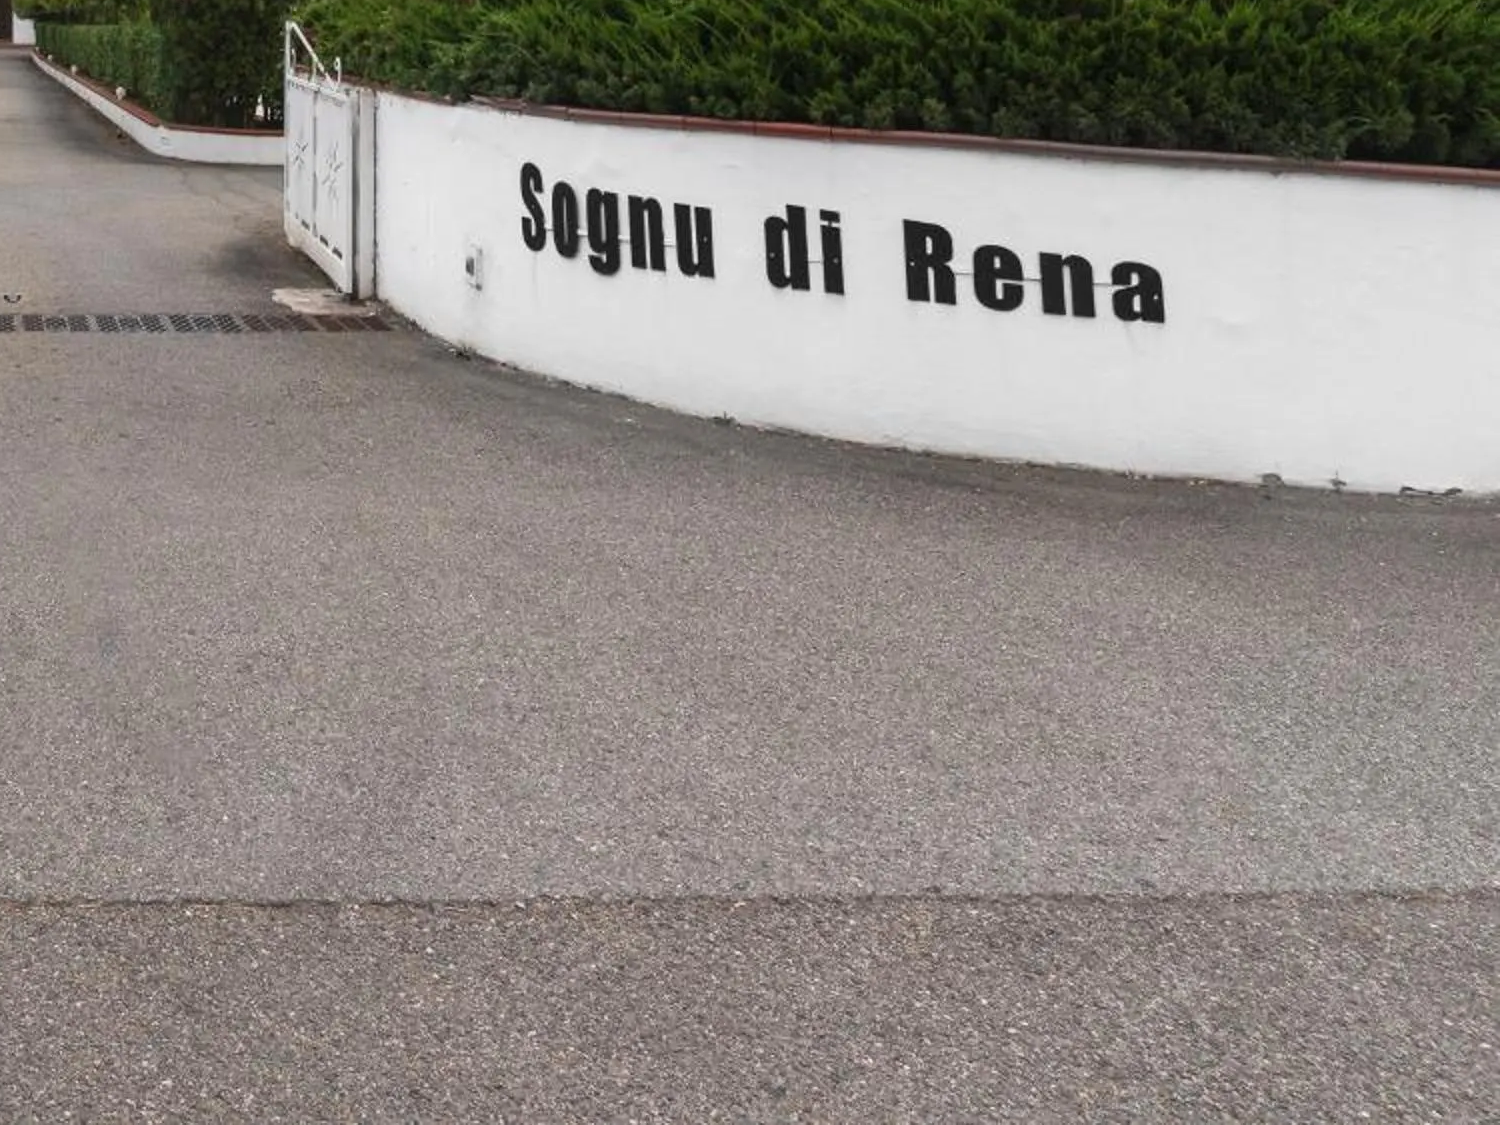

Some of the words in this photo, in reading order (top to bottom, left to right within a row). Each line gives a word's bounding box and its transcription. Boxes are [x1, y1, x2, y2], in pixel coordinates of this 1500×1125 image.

[520, 162, 715, 278] Sognu
[763, 204, 846, 296] di
[902, 218, 1166, 324] Rena
